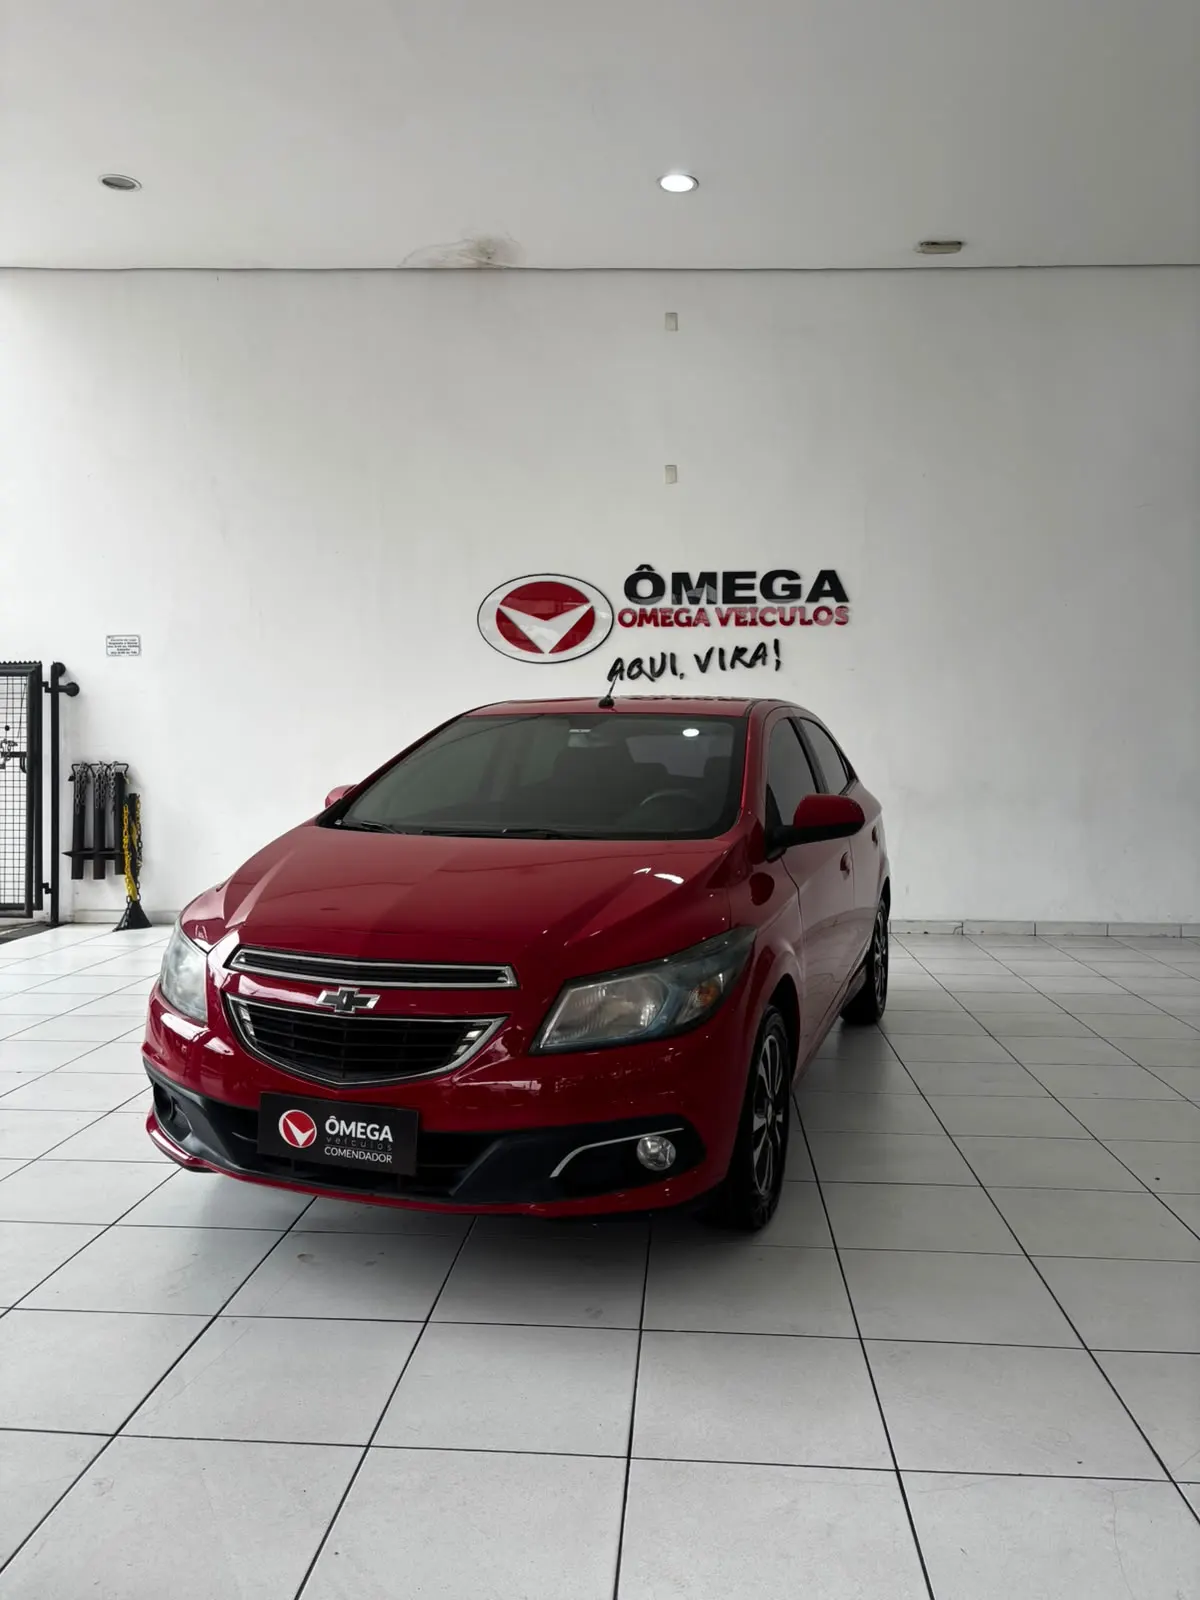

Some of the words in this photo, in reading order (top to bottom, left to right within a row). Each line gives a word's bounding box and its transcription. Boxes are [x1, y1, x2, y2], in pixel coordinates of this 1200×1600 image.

[623, 563, 850, 605] ÔMEGA
[618, 606, 711, 628] OMEGA
[715, 605, 850, 627] VEICULOS
[693, 637, 782, 674] VIRA!
[325, 1115, 394, 1143] ÔMEGA
[324, 1146, 393, 1164] COMENDADOR
